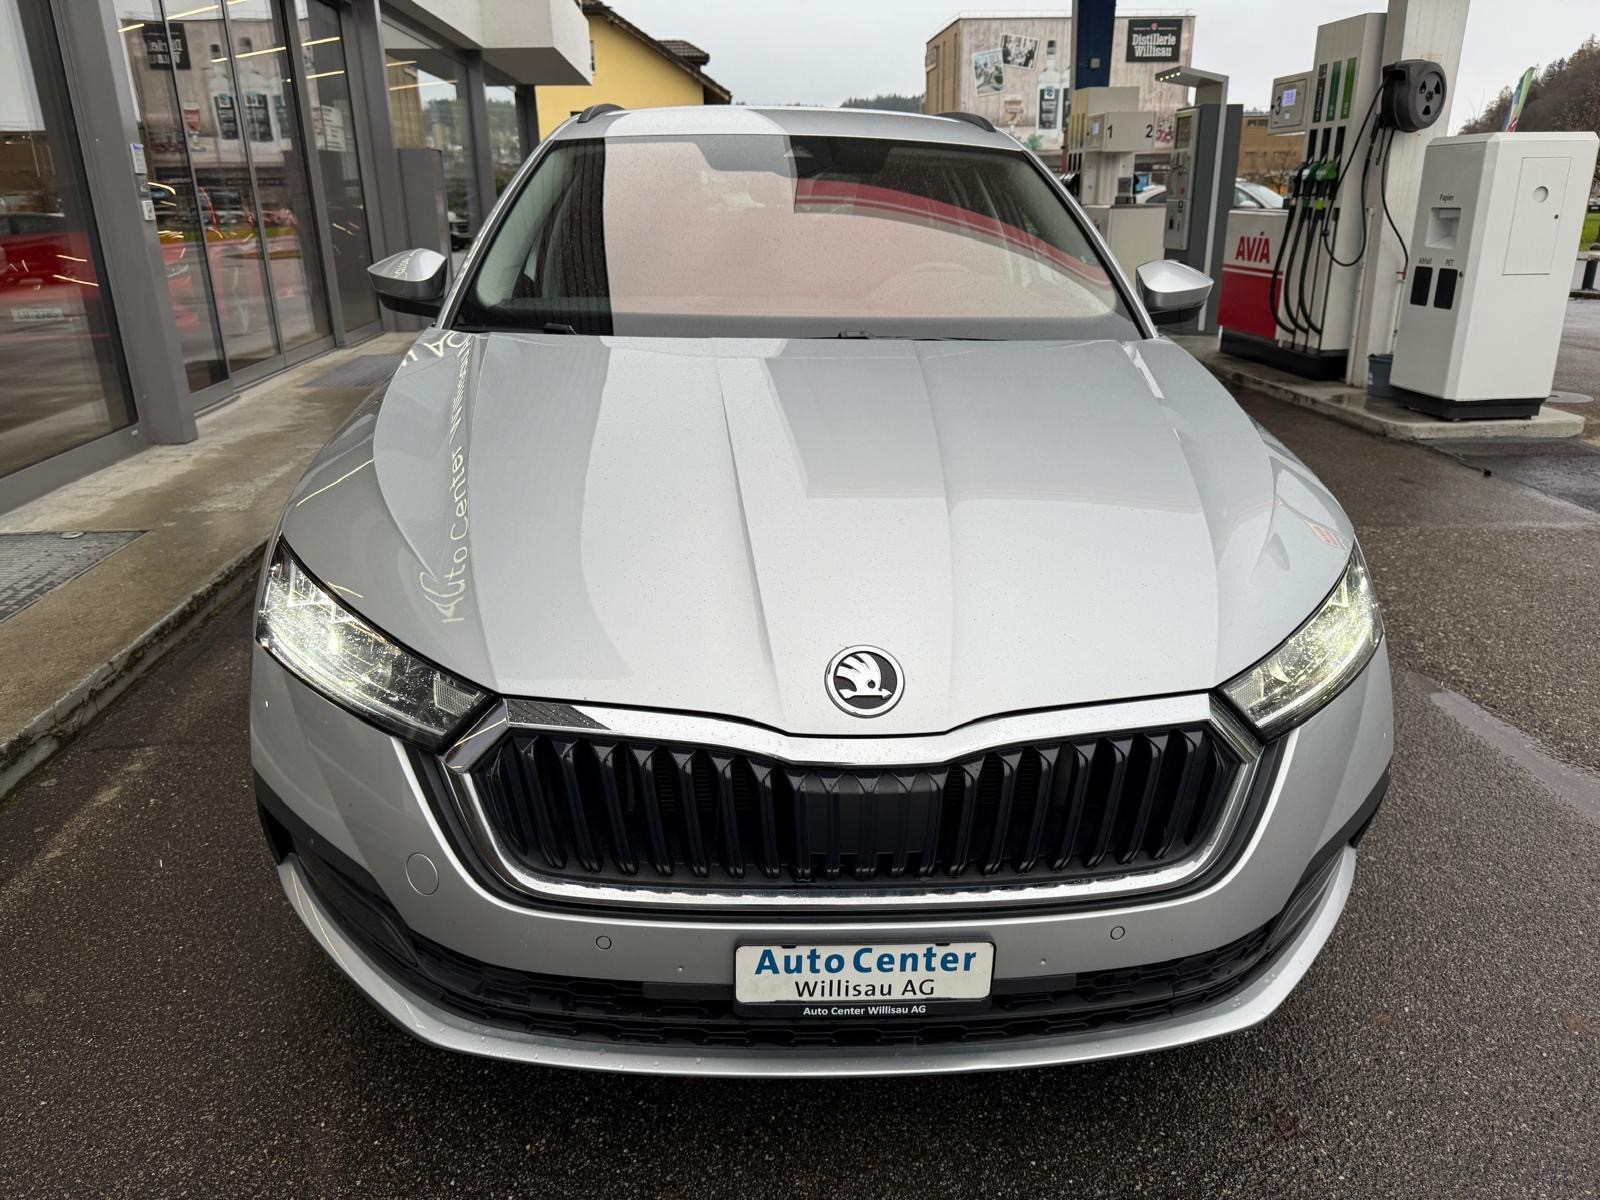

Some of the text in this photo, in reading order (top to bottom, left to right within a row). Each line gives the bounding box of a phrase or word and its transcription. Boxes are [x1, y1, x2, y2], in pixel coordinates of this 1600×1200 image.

[1132, 33, 1176, 46] Distillerie
[1134, 45, 1172, 57] Willisau
[1275, 95, 1282, 115] 3
[1107, 124, 1113, 139] 1
[1145, 124, 1153, 138] 2
[1440, 193, 1454, 203] Papier
[1445, 258, 1455, 266] PET
[450, 446, 468, 541] Center
[754, 945, 977, 975] Auto Center
[795, 979, 935, 998] Willisau AG
[803, 1005, 927, 1016] Auto Center Willisau AG
